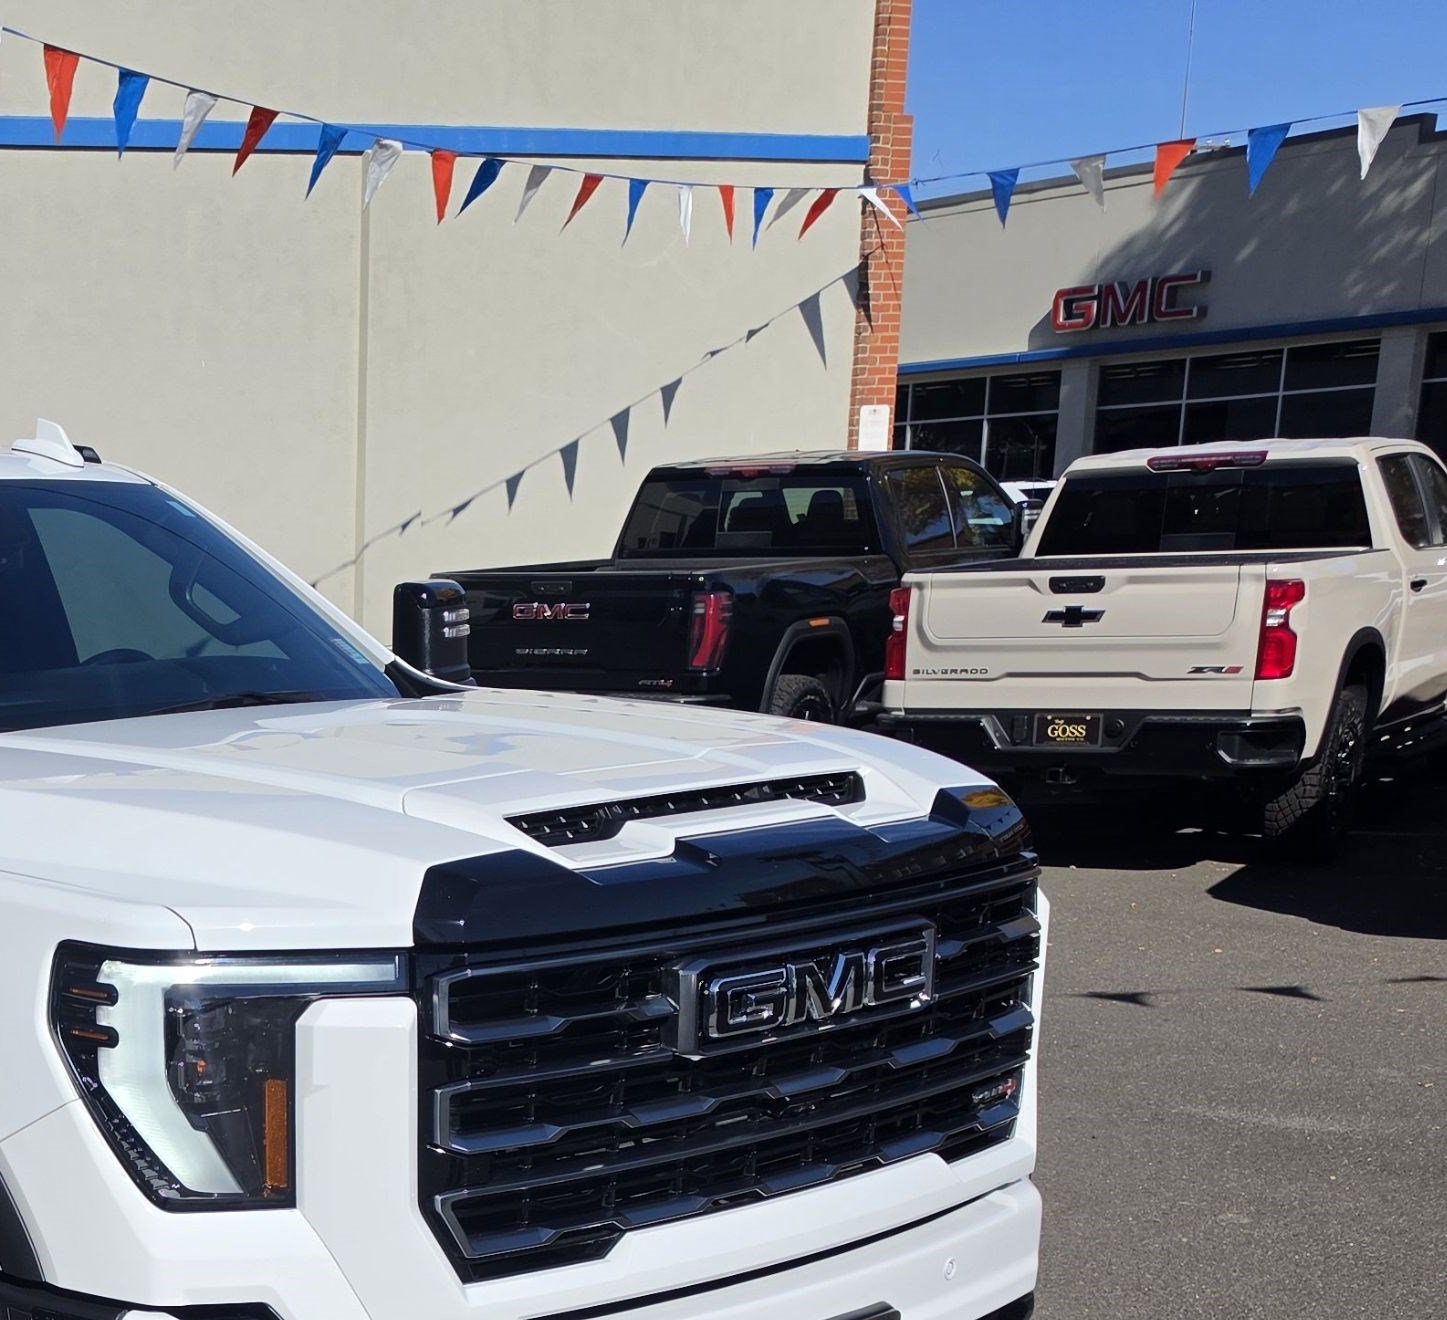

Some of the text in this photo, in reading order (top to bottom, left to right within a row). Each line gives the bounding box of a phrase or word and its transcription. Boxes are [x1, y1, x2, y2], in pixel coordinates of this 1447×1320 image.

[1051, 271, 1207, 333] GMC
[512, 602, 591, 620] GMC
[1047, 724, 1087, 738] GOSS
[709, 932, 932, 1038] GMC
